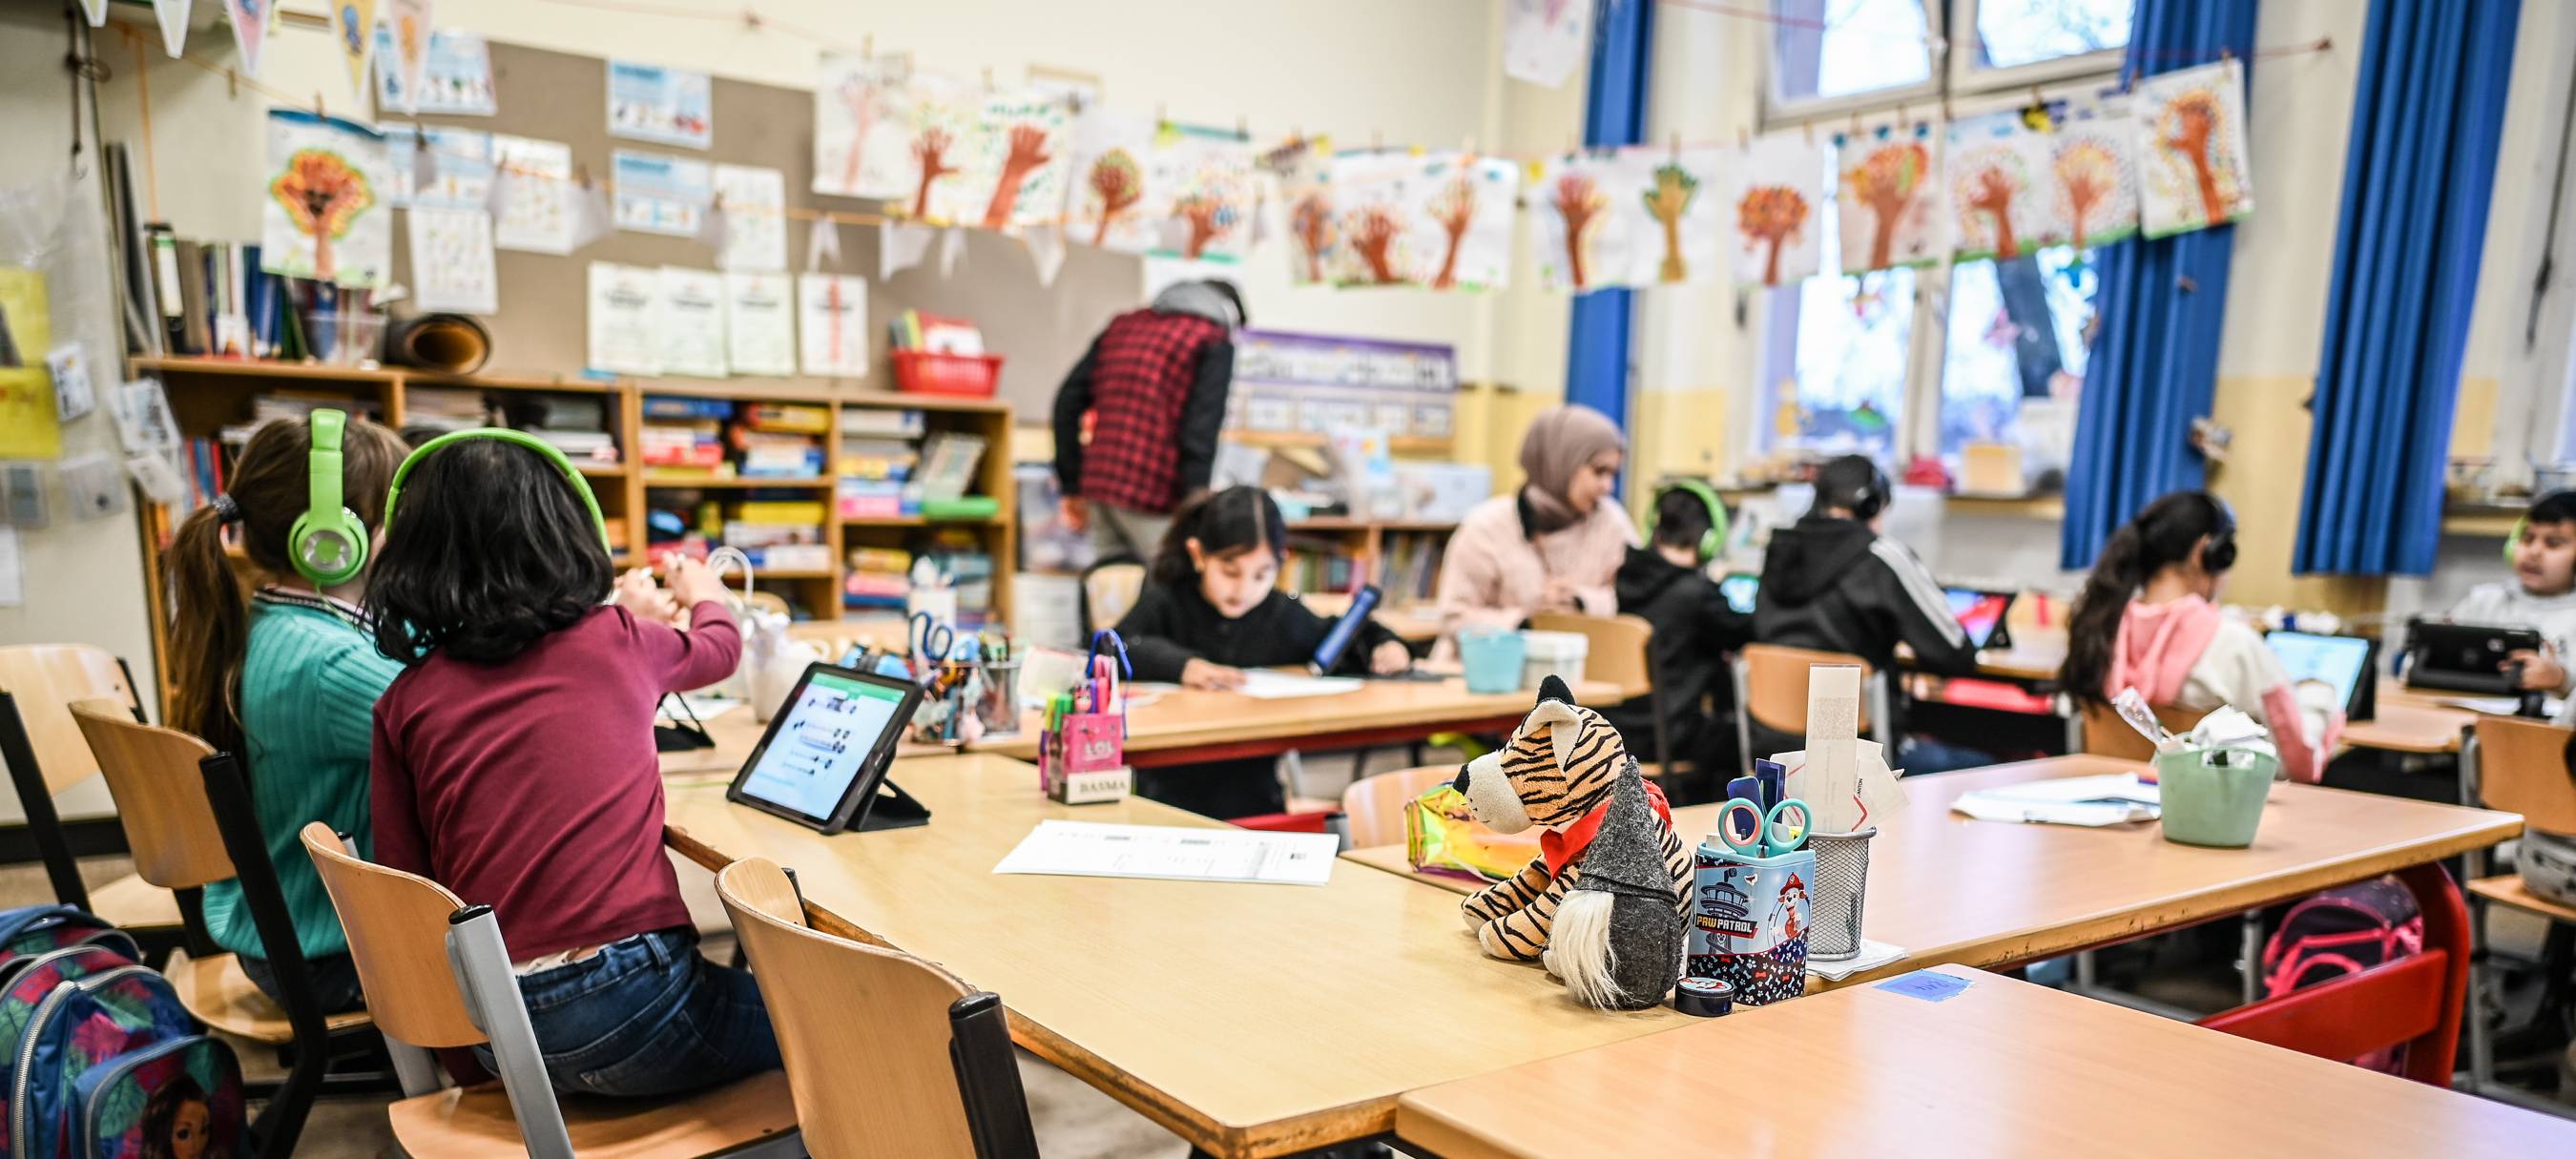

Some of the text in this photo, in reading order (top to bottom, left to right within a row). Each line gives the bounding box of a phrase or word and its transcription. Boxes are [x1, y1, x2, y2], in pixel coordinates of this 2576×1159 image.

[1084, 740, 1115, 757] LOL
[1080, 779, 1126, 794] BASMA
[1696, 916, 1753, 933] PAW PATROL
